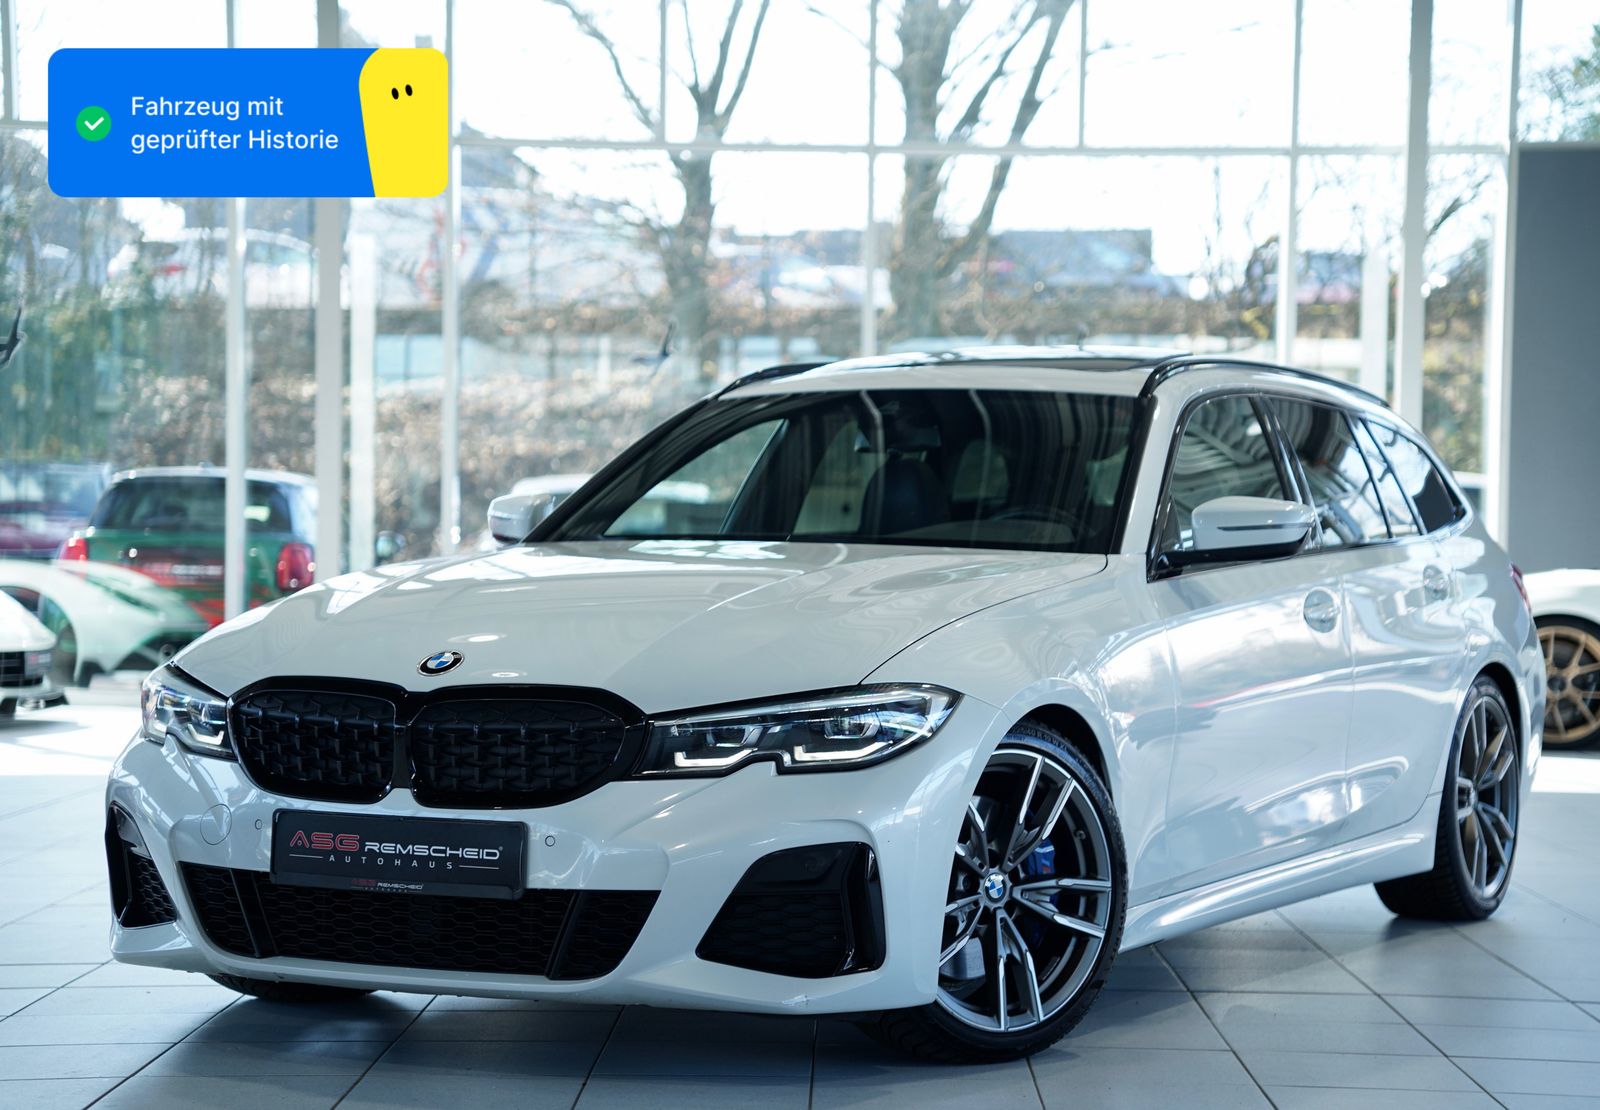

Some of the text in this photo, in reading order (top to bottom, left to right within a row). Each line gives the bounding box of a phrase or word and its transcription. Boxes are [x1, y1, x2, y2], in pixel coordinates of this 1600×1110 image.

[289, 830, 500, 860] ASG REMSCHEID
[328, 854, 453, 870] AUTOHAUS
